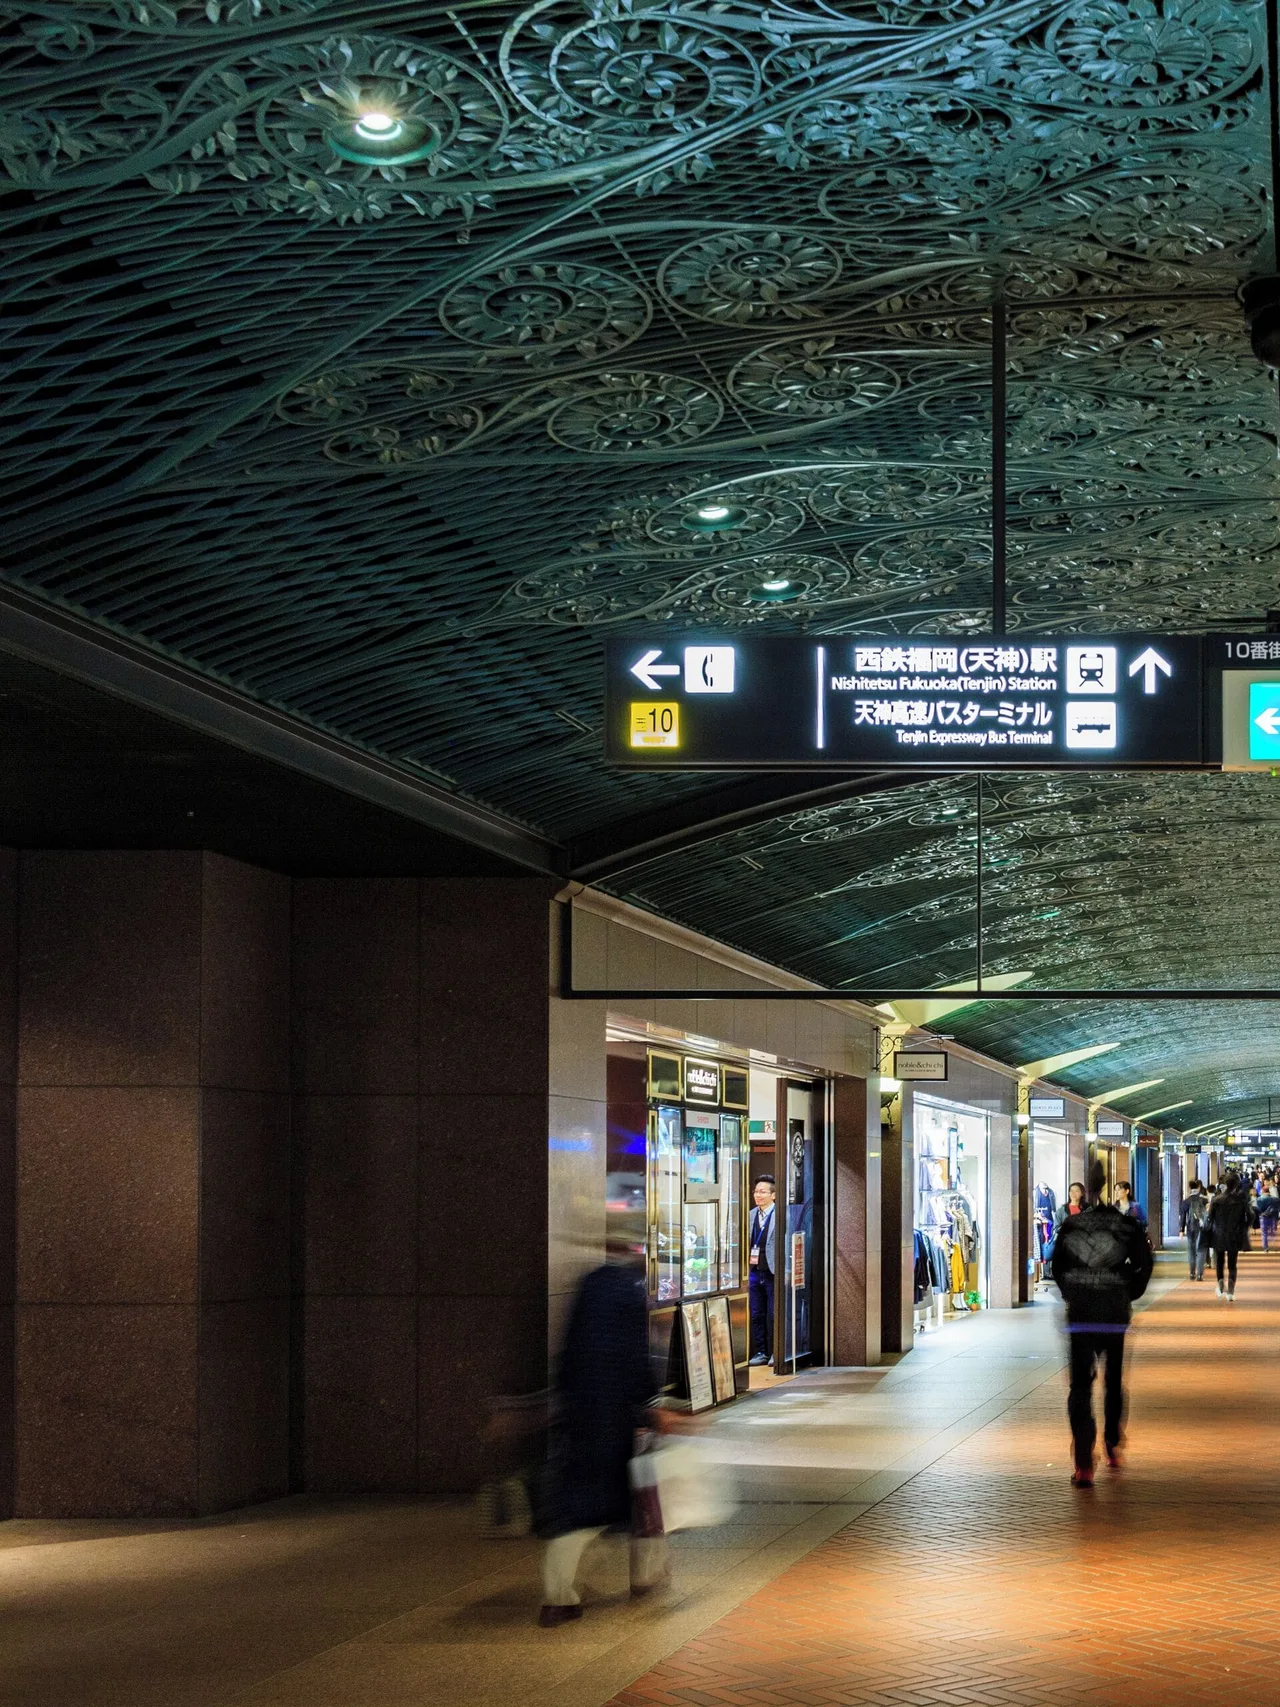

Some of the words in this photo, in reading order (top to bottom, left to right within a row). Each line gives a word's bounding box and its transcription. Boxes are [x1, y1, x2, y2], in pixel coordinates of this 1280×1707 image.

[855, 647, 1058, 673] 西鉄福岡(天神)駅
[831, 676, 897, 691] Nishitetsu
[900, 676, 1006, 693] Fukuoka(Tenjin)
[1008, 676, 1057, 691] Station
[854, 700, 1053, 726] 天神高速バスターミナル
[896, 730, 928, 747] Tenjin
[929, 730, 987, 747] Expressway
[988, 730, 1007, 744] Bus
[1008, 730, 1053, 744] Terminal
